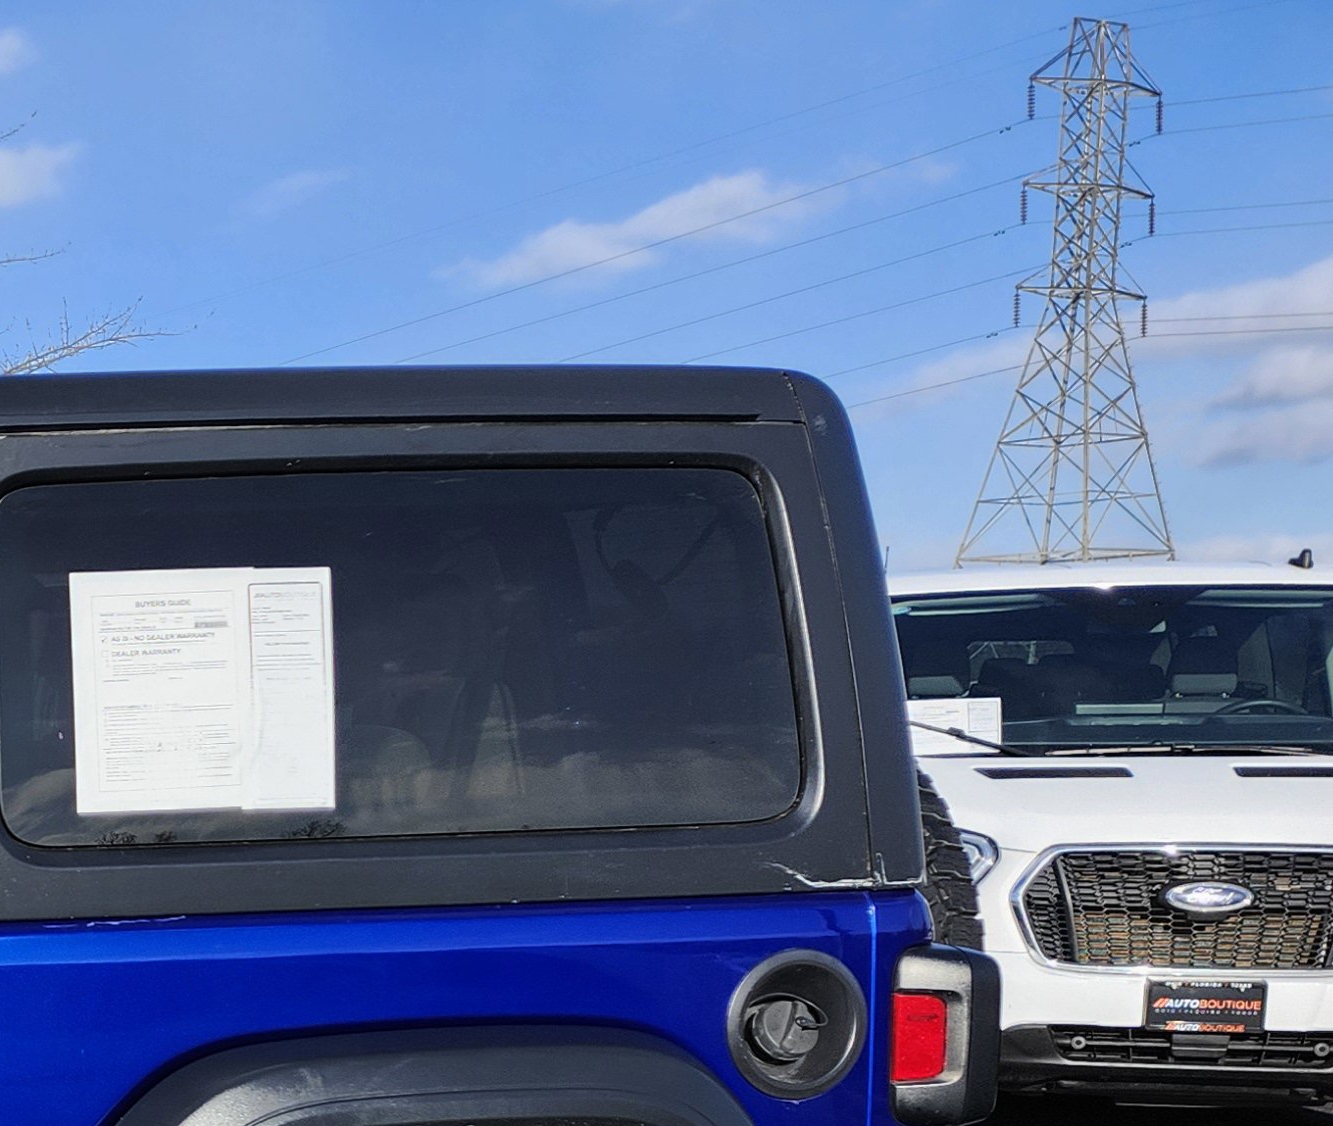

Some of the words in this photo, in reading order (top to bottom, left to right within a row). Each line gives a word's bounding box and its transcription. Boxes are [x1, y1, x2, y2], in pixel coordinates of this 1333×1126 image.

[135, 600, 166, 608] BUYERS
[168, 599, 191, 607] GUIDE
[146, 633, 174, 641] DEALER
[176, 631, 216, 640] WARRANTY
[111, 649, 139, 657] DEALER
[141, 648, 181, 656] WARRANTY
[1185, 886, 1235, 905] Ford
[1164, 998, 1263, 1010] AUTOBOUTIQUE
